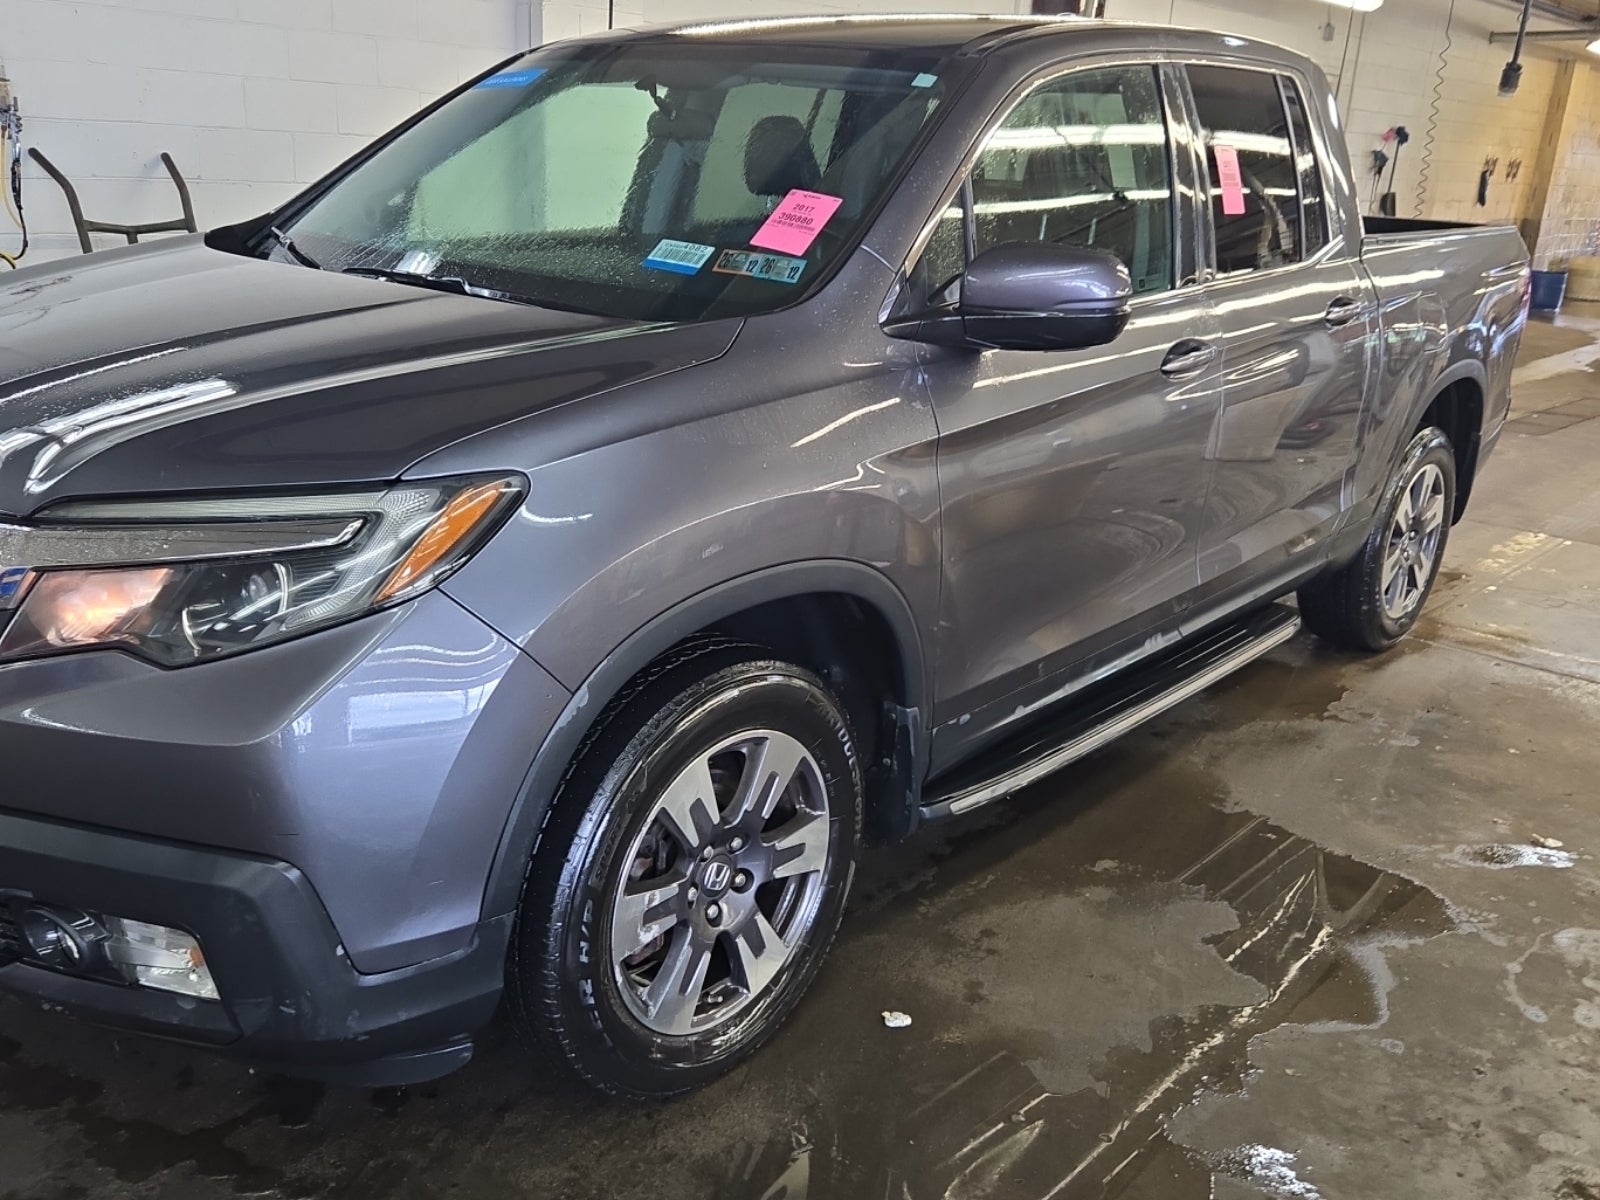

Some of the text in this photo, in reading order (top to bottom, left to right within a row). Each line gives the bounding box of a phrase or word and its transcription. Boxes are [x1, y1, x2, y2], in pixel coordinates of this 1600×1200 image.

[793, 203, 816, 213] 2017
[746, 260, 759, 273] 12
[787, 266, 800, 279] 12
